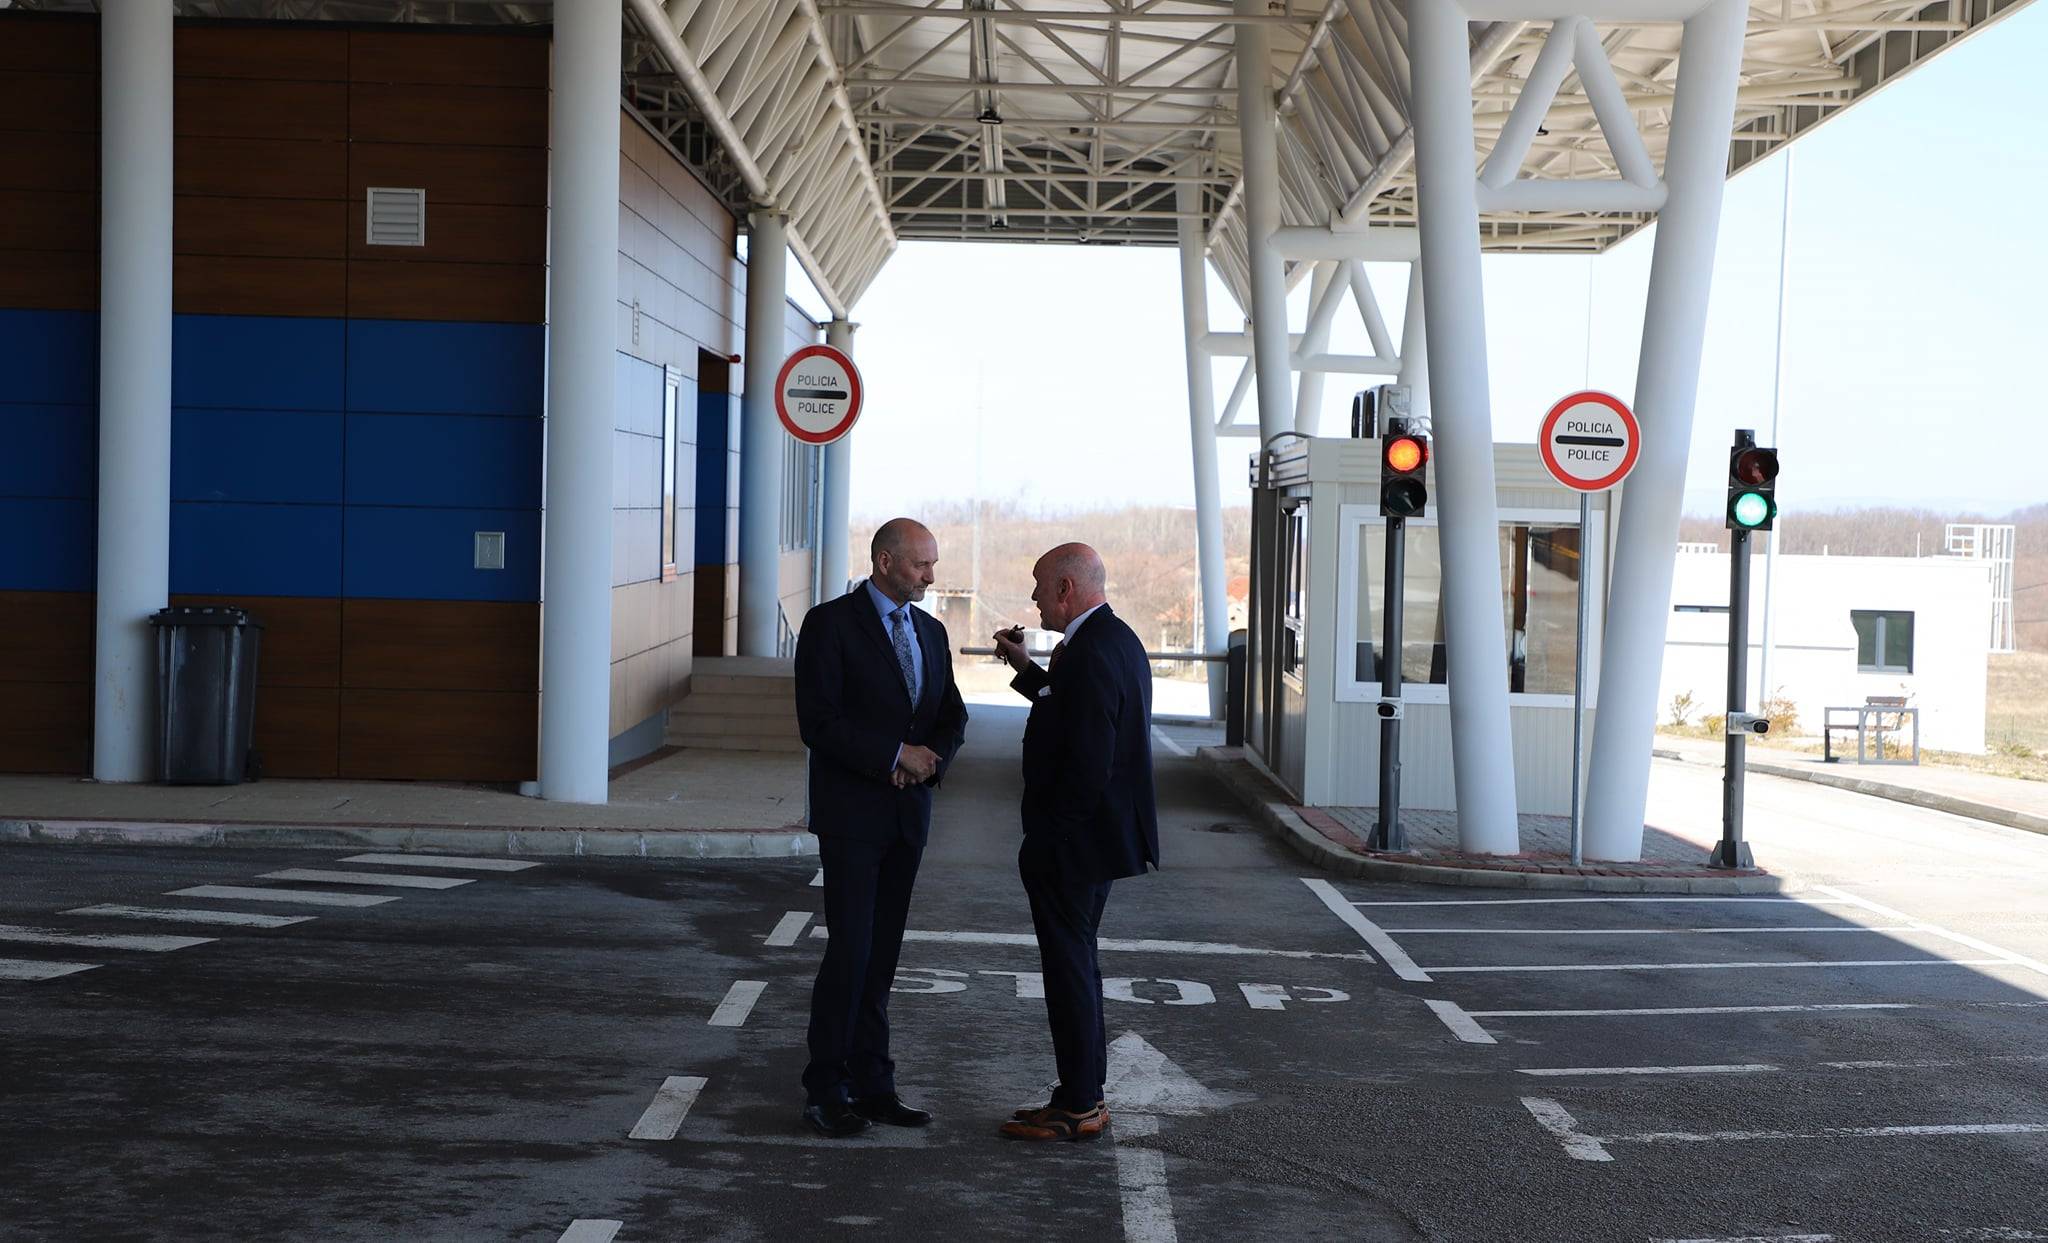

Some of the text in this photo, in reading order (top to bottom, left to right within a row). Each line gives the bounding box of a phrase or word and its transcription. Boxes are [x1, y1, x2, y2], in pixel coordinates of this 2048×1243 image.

[797, 374, 838, 387] POLICIA
[798, 402, 836, 415] POLICE
[1567, 421, 1614, 434] POLICIA
[1567, 448, 1610, 462] POLICE
[890, 967, 1351, 1010] STOP
